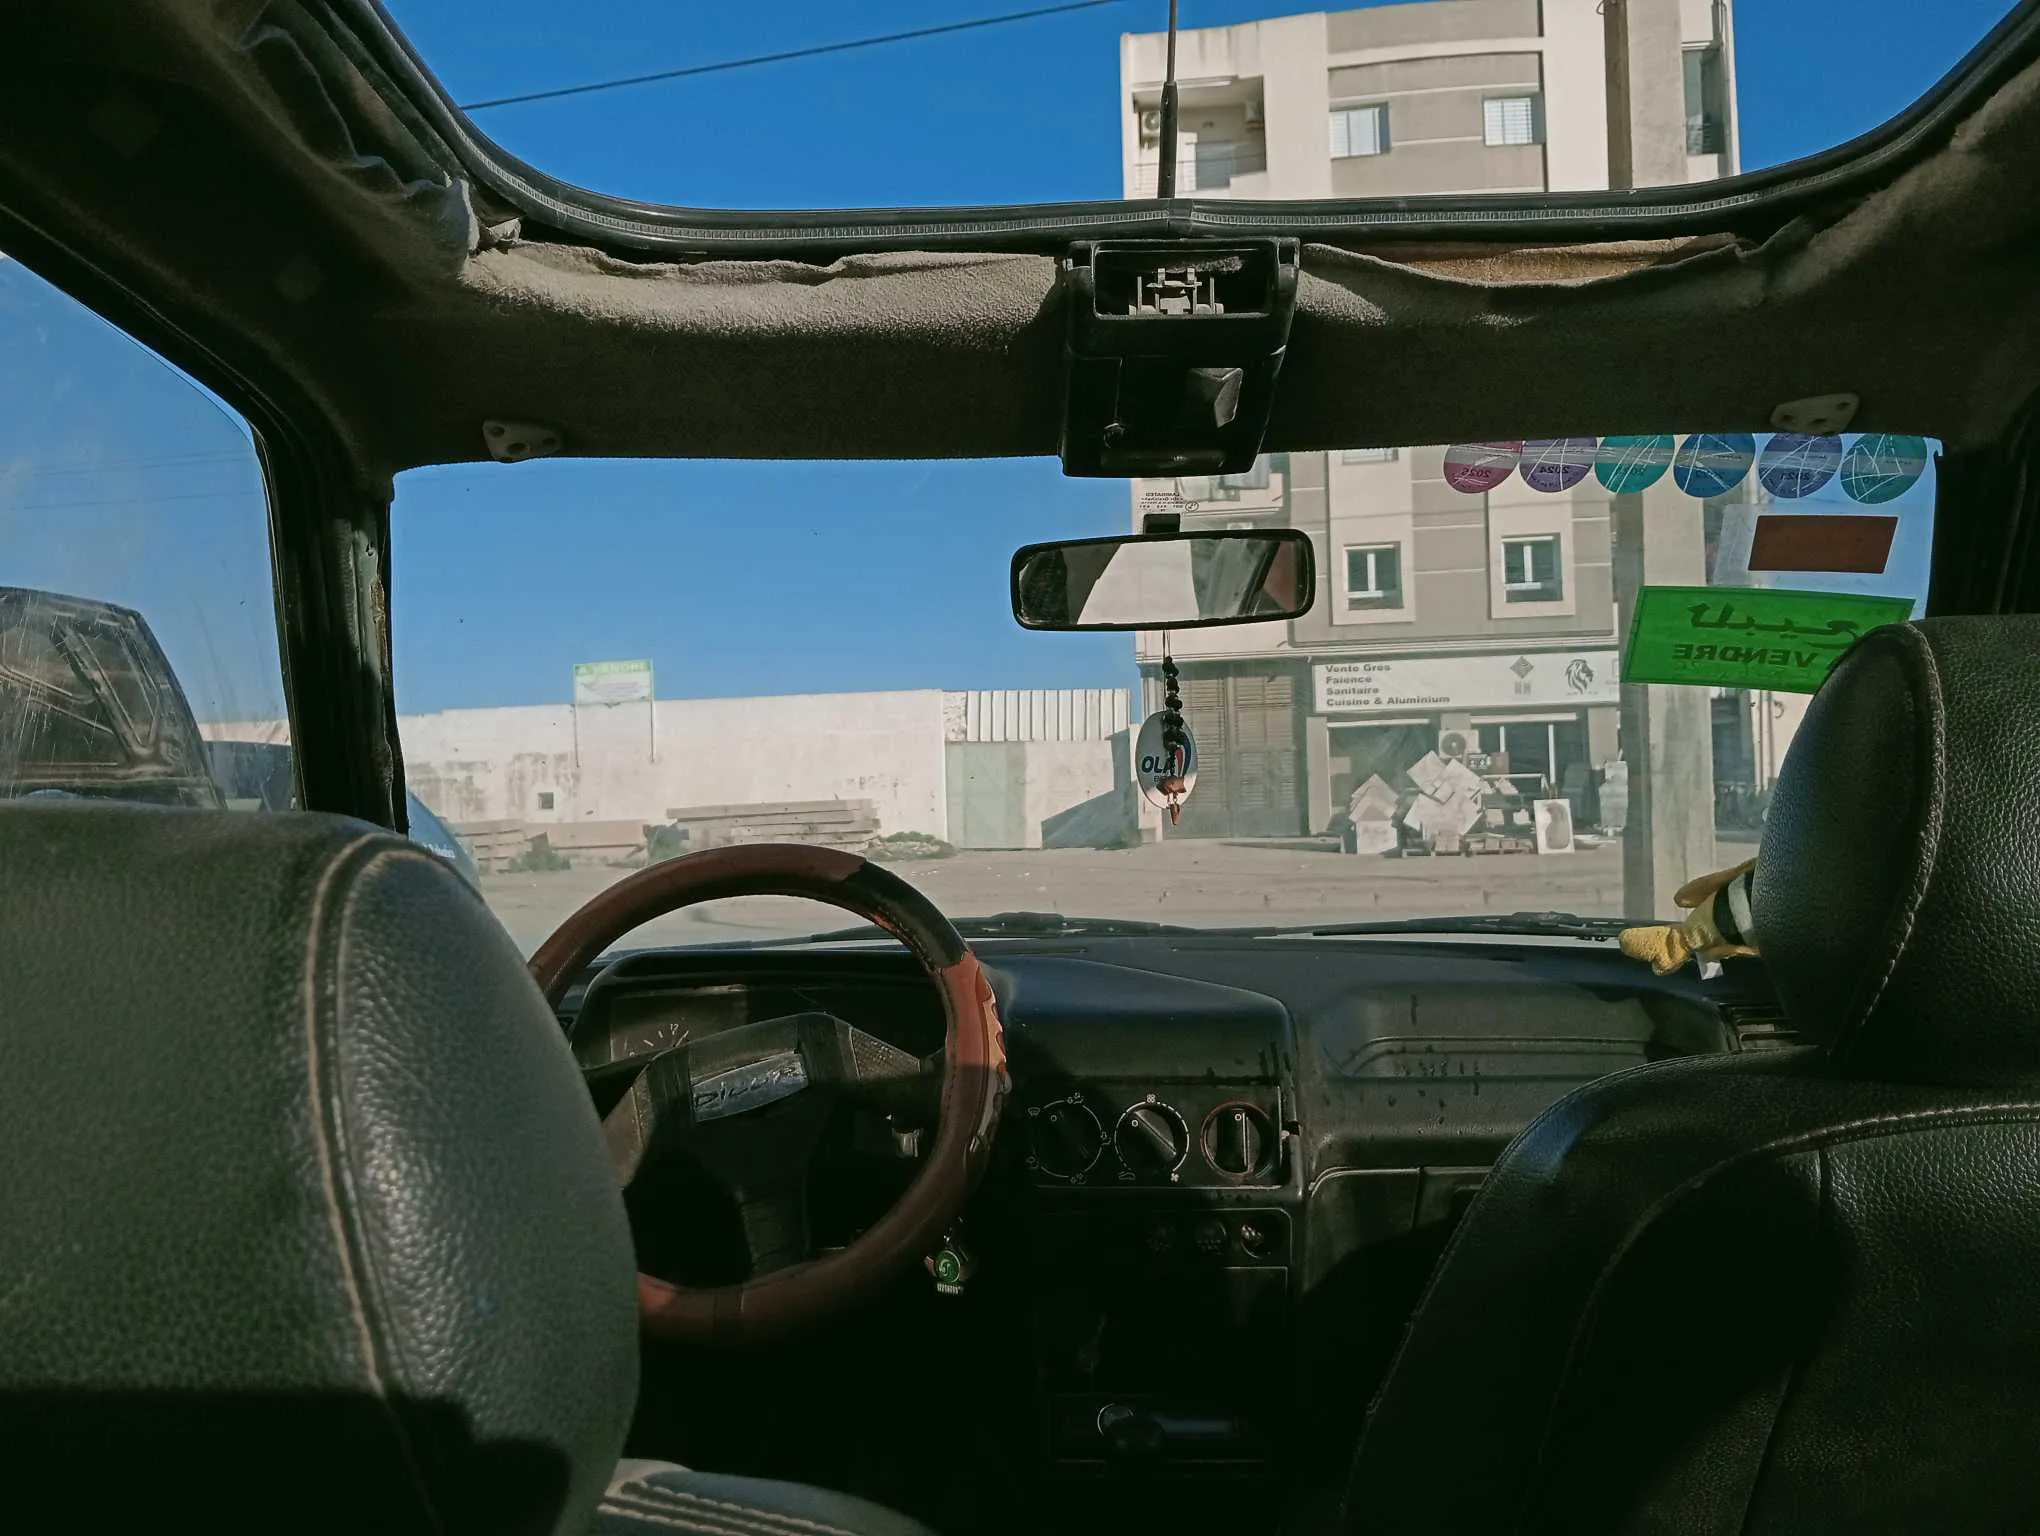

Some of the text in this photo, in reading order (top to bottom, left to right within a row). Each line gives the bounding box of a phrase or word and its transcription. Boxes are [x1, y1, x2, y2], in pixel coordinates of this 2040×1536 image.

[1325, 664, 1360, 673] Vente
[1326, 687, 1380, 696] Sanitaire
[1326, 695, 1450, 707] Cuisine & Aluminium
